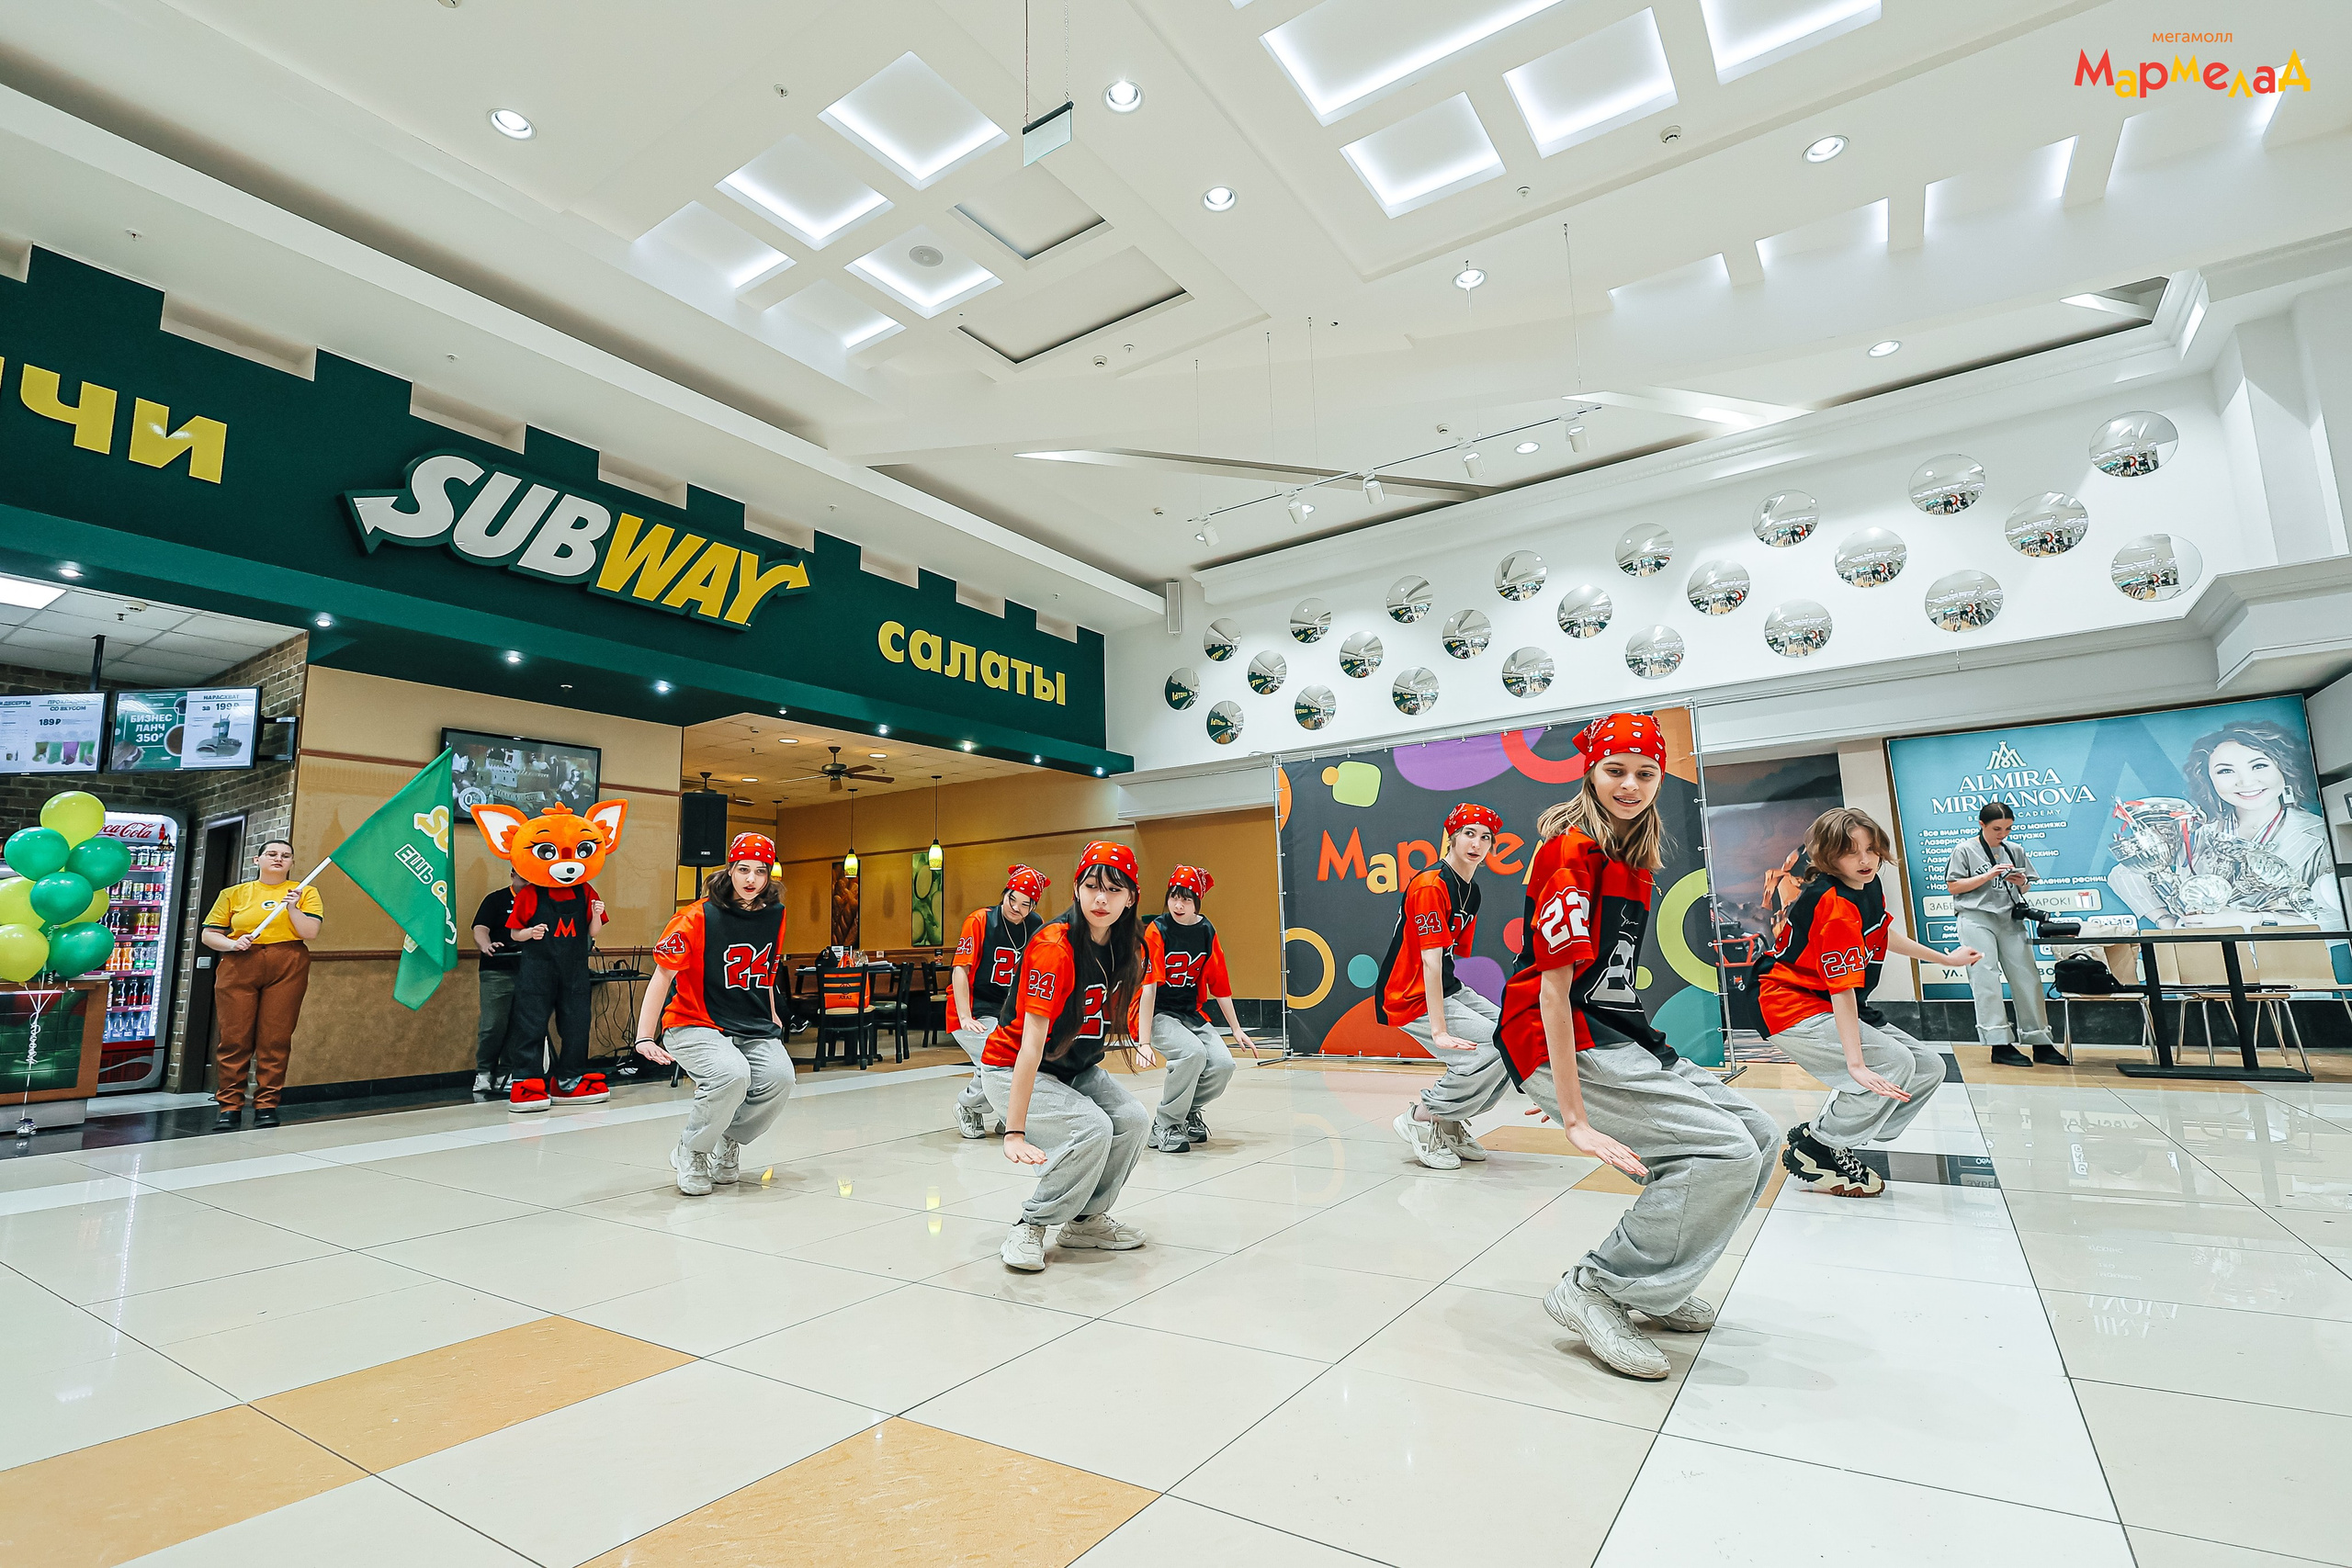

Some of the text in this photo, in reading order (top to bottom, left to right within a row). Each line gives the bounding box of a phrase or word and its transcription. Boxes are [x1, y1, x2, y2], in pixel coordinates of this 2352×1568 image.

[0, 355, 228, 485] чи
[353, 455, 810, 626] SUBWAY
[877, 620, 1066, 705] салаты
[130, 714, 173, 723] БИЗНЕС
[135, 723, 165, 732] ЛАНЧ
[1958, 767, 2063, 793] ALMIRA
[2014, 809, 2062, 819] CADEMY
[2072, 876, 2108, 885] ресниц
[1415, 911, 1442, 937] 24
[1537, 886, 1591, 955] 22
[956, 936, 974, 955] 24
[723, 942, 773, 991] 24
[990, 946, 1022, 987] 2
[1164, 951, 1208, 988] 24
[1820, 946, 1866, 979] 24
[1027, 969, 1057, 1000] 24
